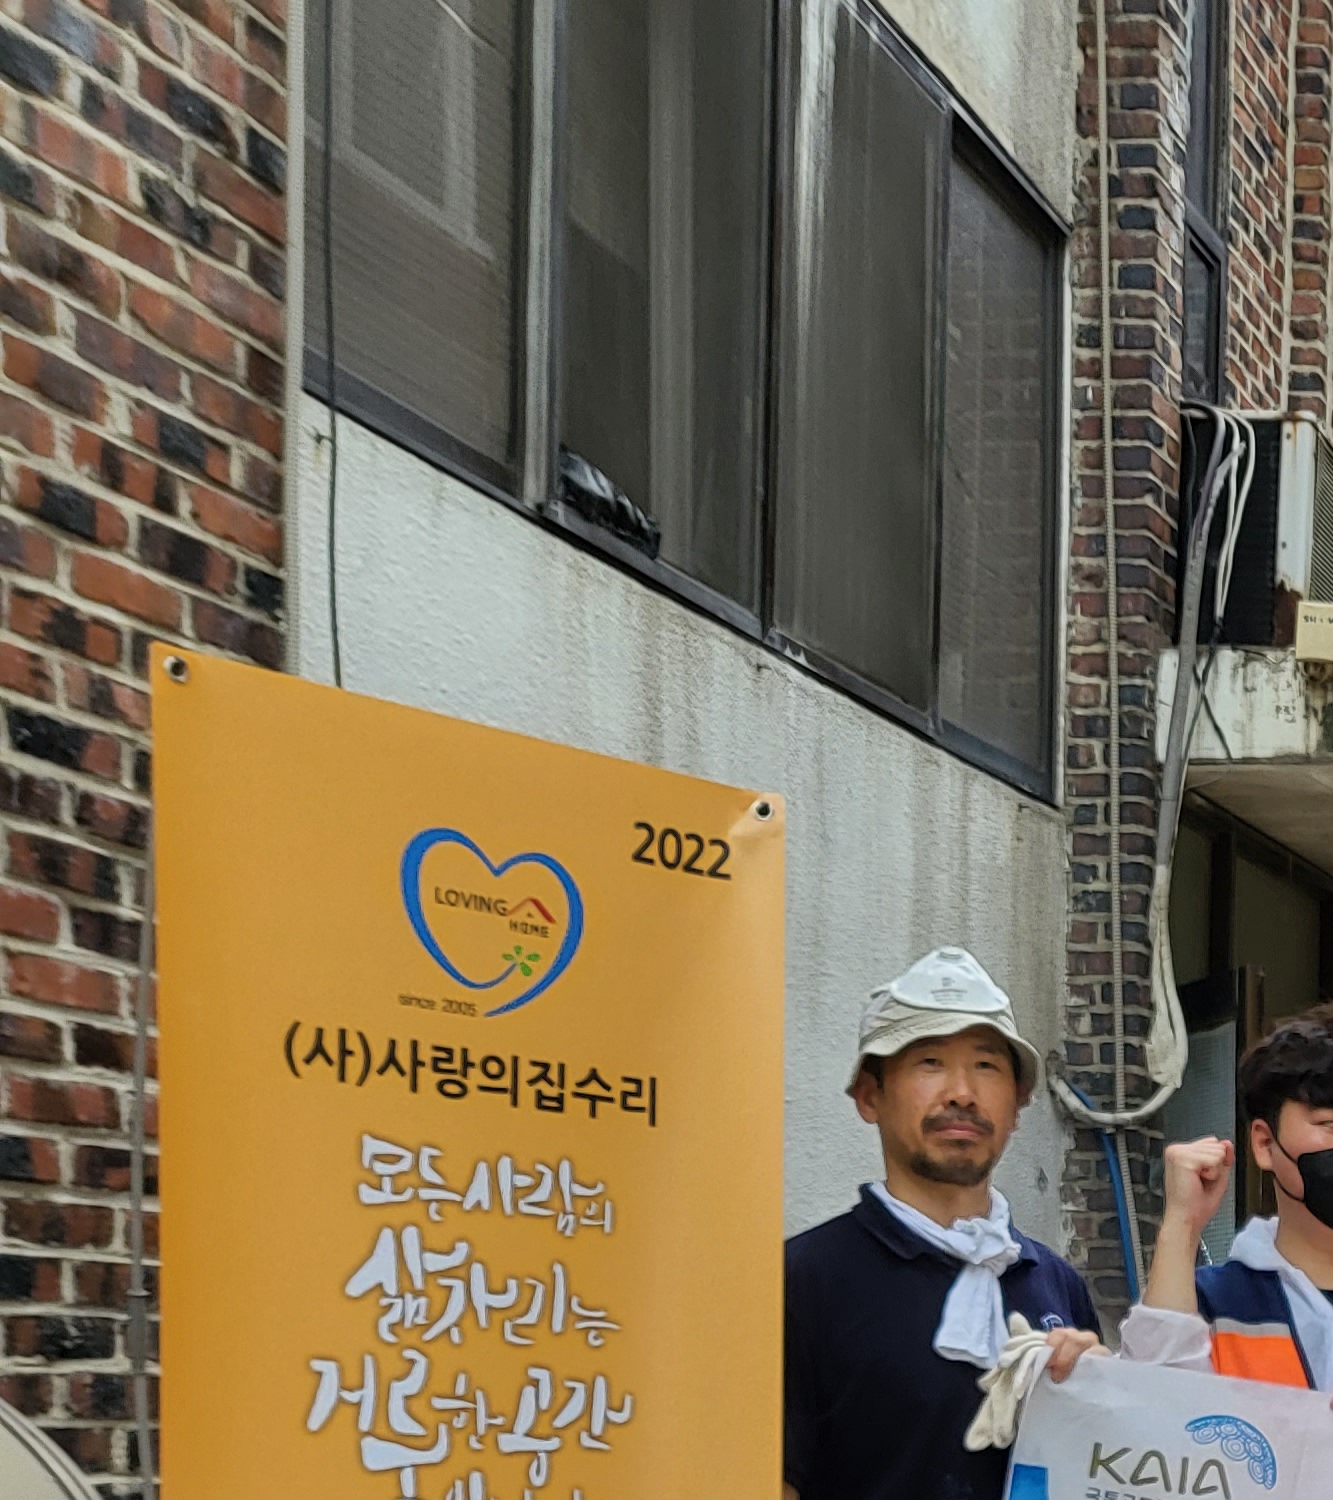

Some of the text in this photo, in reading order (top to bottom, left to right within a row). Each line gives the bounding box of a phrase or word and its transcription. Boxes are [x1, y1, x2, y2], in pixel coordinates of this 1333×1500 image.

[631, 821, 731, 880] 2022
[434, 886, 508, 916] LOVING
[509, 919, 550, 938] HOME
[399, 994, 437, 1010] since
[284, 1021, 659, 1127] (사)사랑의집수리
[1089, 1442, 1232, 1500] KAIA
